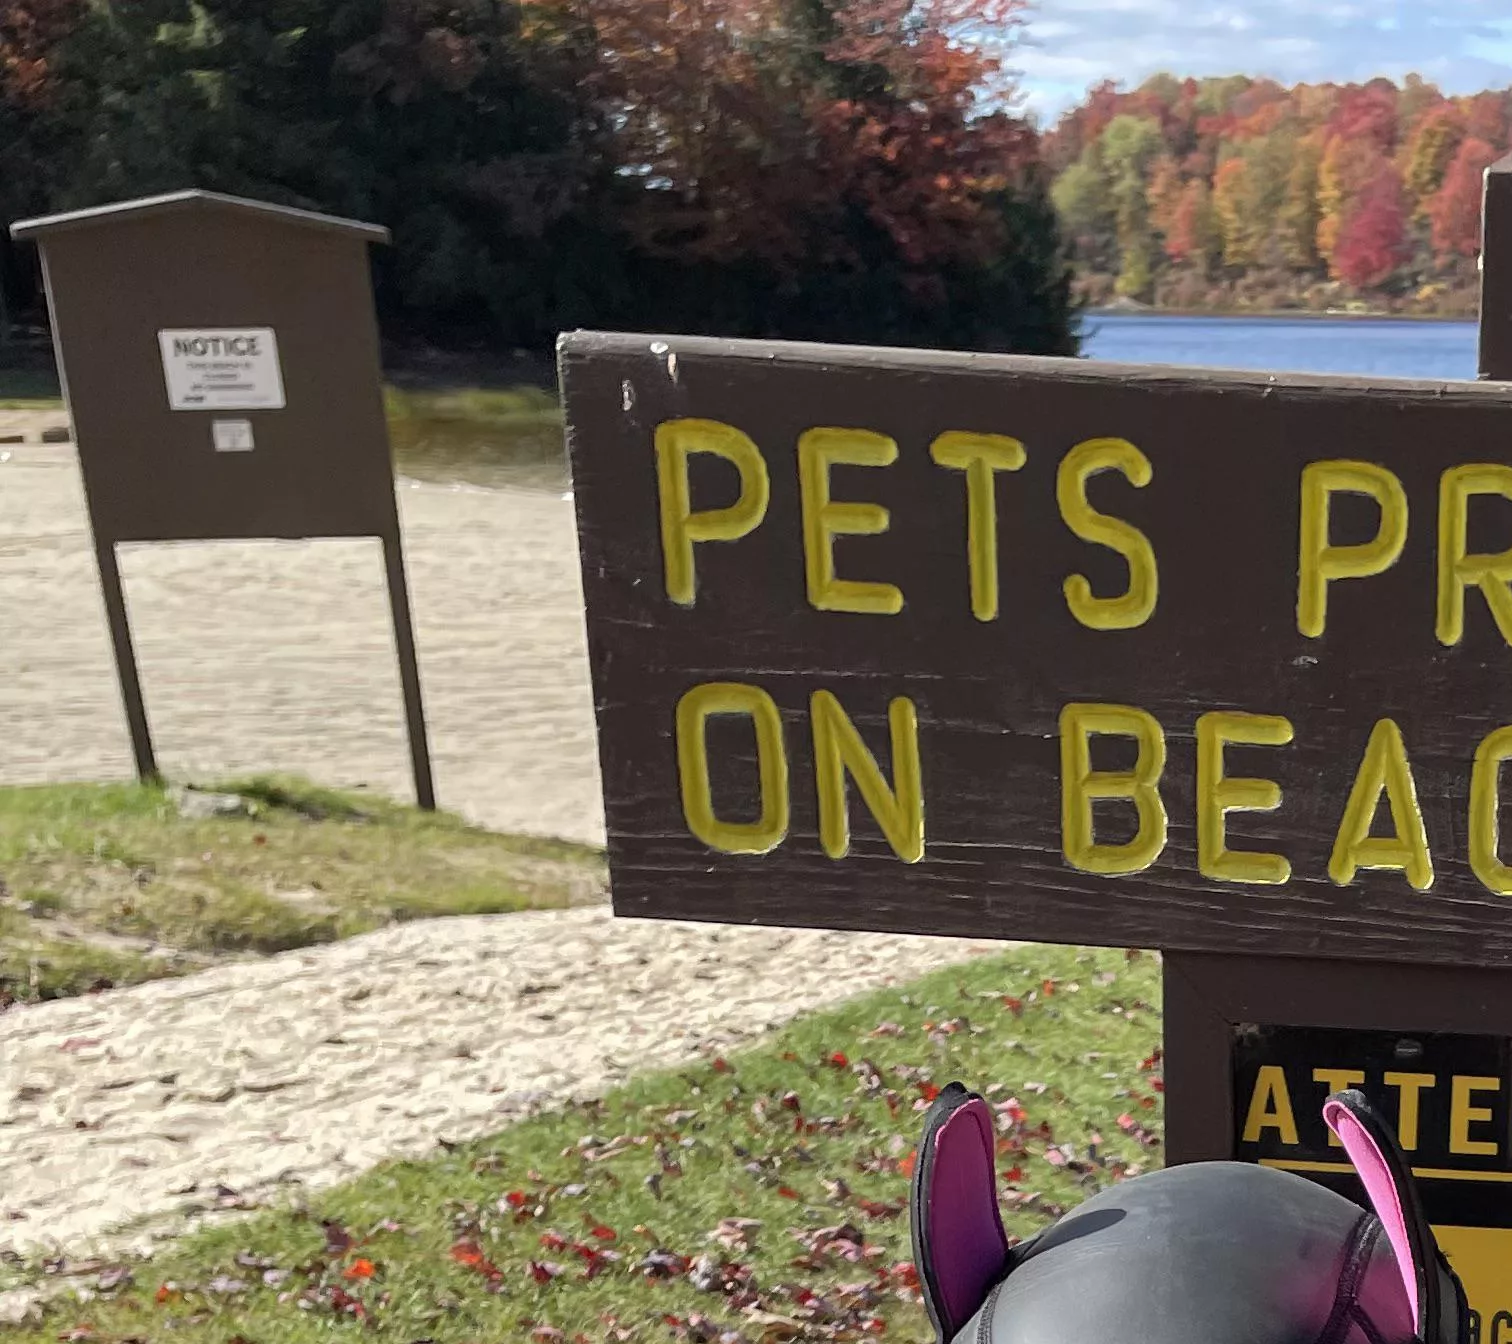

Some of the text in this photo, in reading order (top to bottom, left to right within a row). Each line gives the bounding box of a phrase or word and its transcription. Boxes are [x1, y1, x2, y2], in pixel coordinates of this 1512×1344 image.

[173, 336, 262, 357] NOTICE
[655, 417, 1158, 630] PETS
[676, 682, 924, 863] ON
